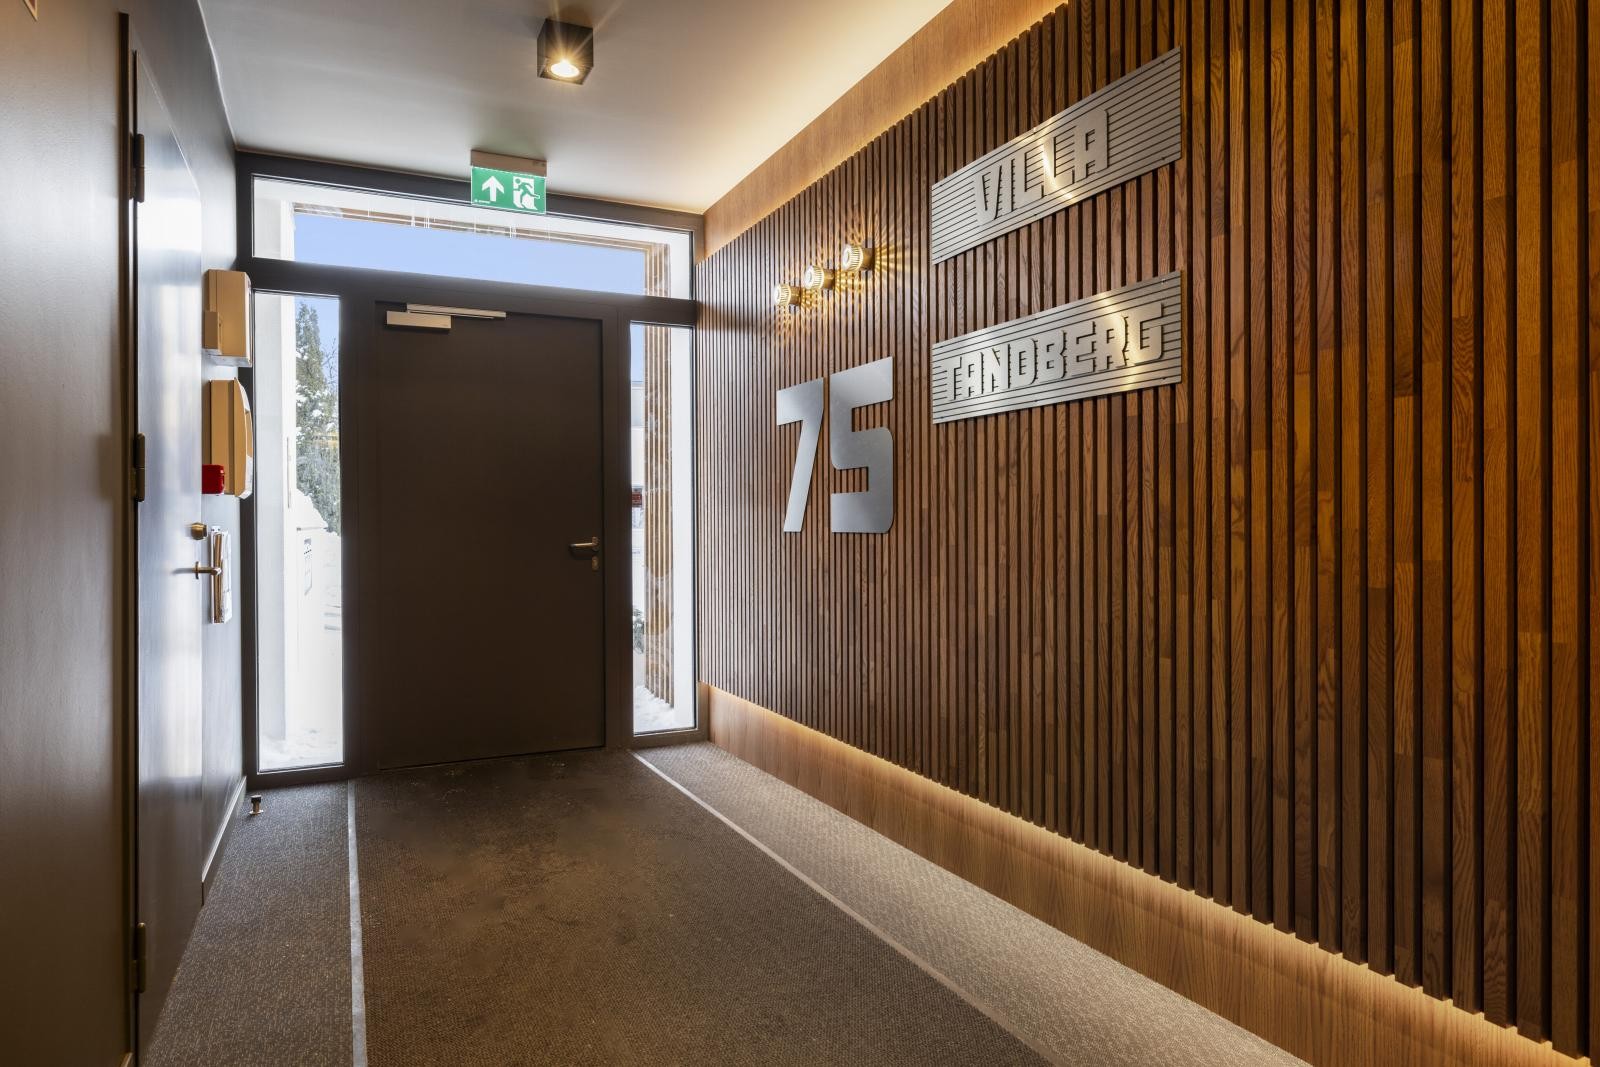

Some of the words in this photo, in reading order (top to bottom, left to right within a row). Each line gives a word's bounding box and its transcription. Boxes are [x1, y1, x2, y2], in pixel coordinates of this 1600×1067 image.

[974, 107, 1109, 228] VILLA
[945, 303, 1165, 401] TANDBERG
[776, 356, 894, 534] 75
